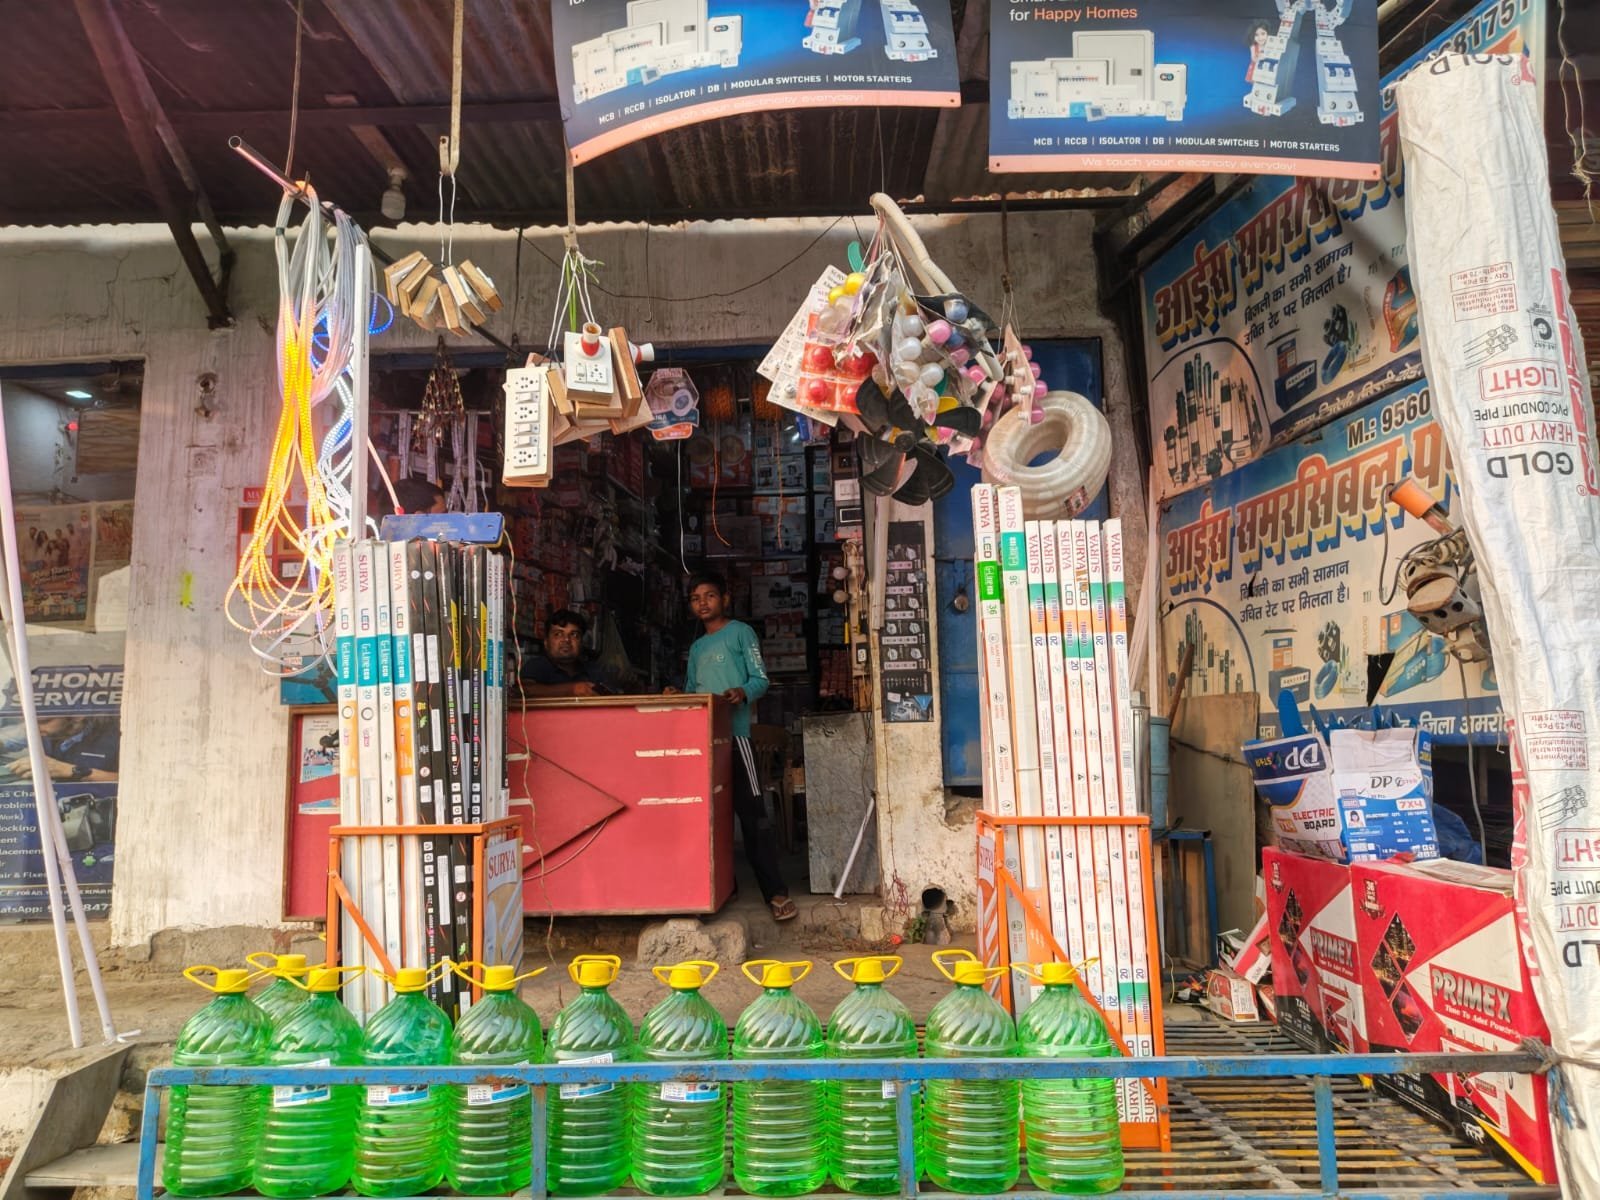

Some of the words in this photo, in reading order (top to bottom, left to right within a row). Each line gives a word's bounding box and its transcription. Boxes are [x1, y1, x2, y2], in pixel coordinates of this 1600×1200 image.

[1009, 9, 1030, 21] for
[1034, 8, 1081, 22] Happy
[1086, 7, 1137, 19] Homes
[599, 112, 614, 124] MCB
[624, 102, 645, 115] RCCB
[655, 89, 696, 105] ISOLATOR
[707, 84, 720, 93] DB
[731, 78, 774, 89] MODULAR
[775, 75, 822, 85] SWITCHES
[833, 75, 864, 83] MOTOR
[866, 75, 912, 83] STARTERS
[1033, 136, 1053, 146] MCB
[1064, 136, 1088, 146] RCCB
[1099, 136, 1141, 146] ISOLATOR
[1152, 137, 1164, 145] DB
[1175, 137, 1216, 147] MODULAR
[1217, 138, 1259, 148] SWITCHES
[1270, 140, 1298, 149] MOTOR
[1298, 142, 1340, 152] STARTERS
[1106, 157, 1144, 167] touch
[1146, 159, 1173, 170] your
[1314, 241, 1353, 275] सामान
[1489, 366, 1558, 393] LIGHT
[1474, 406, 1500, 421] PIPE
[1502, 401, 1551, 417] CONDUIT
[1551, 403, 1569, 417] PVC
[1481, 424, 1524, 446] DUTY
[1530, 422, 1574, 442] HEAVY
[1486, 449, 1574, 479] GOLD
[978, 488, 991, 529] SURYA
[1005, 489, 1017, 529] SURYA
[983, 536, 992, 559] LED
[1029, 534, 1041, 574] SURYA
[1043, 534, 1055, 573] SURYA
[1060, 531, 1072, 570] SURYA
[1089, 534, 1101, 573] SURYA
[1110, 532, 1122, 572] SURYA
[337, 554, 348, 593] SURYA
[358, 554, 369, 593] SURYA
[393, 553, 403, 591] SURYA
[1008, 575, 1018, 586] 36
[1272, 577, 1285, 593] का
[1288, 566, 1309, 589] सभी
[1313, 560, 1349, 583] सामान
[1064, 583, 1074, 606] LED
[1075, 531, 1087, 570] SURYA
[1085, 660, 1093, 671] 20
[1282, 599, 1295, 614] पर
[1299, 589, 1333, 611] मिलता
[340, 607, 349, 630] LED
[361, 608, 370, 631] LED
[396, 606, 404, 629] LED
[988, 604, 998, 615] 36
[1034, 636, 1043, 647] 20
[1049, 635, 1058, 646] 20
[1095, 635, 1104, 646] 20
[1115, 634, 1125, 646] 20
[1070, 660, 1079, 671] 20
[343, 687, 352, 698] 20
[383, 686, 391, 696] 20
[1419, 710, 1456, 735] जिला
[1460, 707, 1509, 735] अमरो
[1370, 775, 1393, 789] DP
[0, 801, 36, 809] roblem
[1292, 807, 1335, 821] ELECTRIC
[1400, 800, 1423, 809] 7X4
[1303, 818, 1336, 831] BOARD
[488, 849, 517, 880] SURYA
[1559, 904, 1598, 929] DUTY
[1310, 928, 1354, 968] PRIMEX
[1135, 968, 1145, 979] 20
[1109, 995, 1118, 1007] 20
[1431, 968, 1511, 1024] PRIMEX
[1119, 968, 1129, 979] 20
[1127, 1079, 1141, 1122] SURYA
